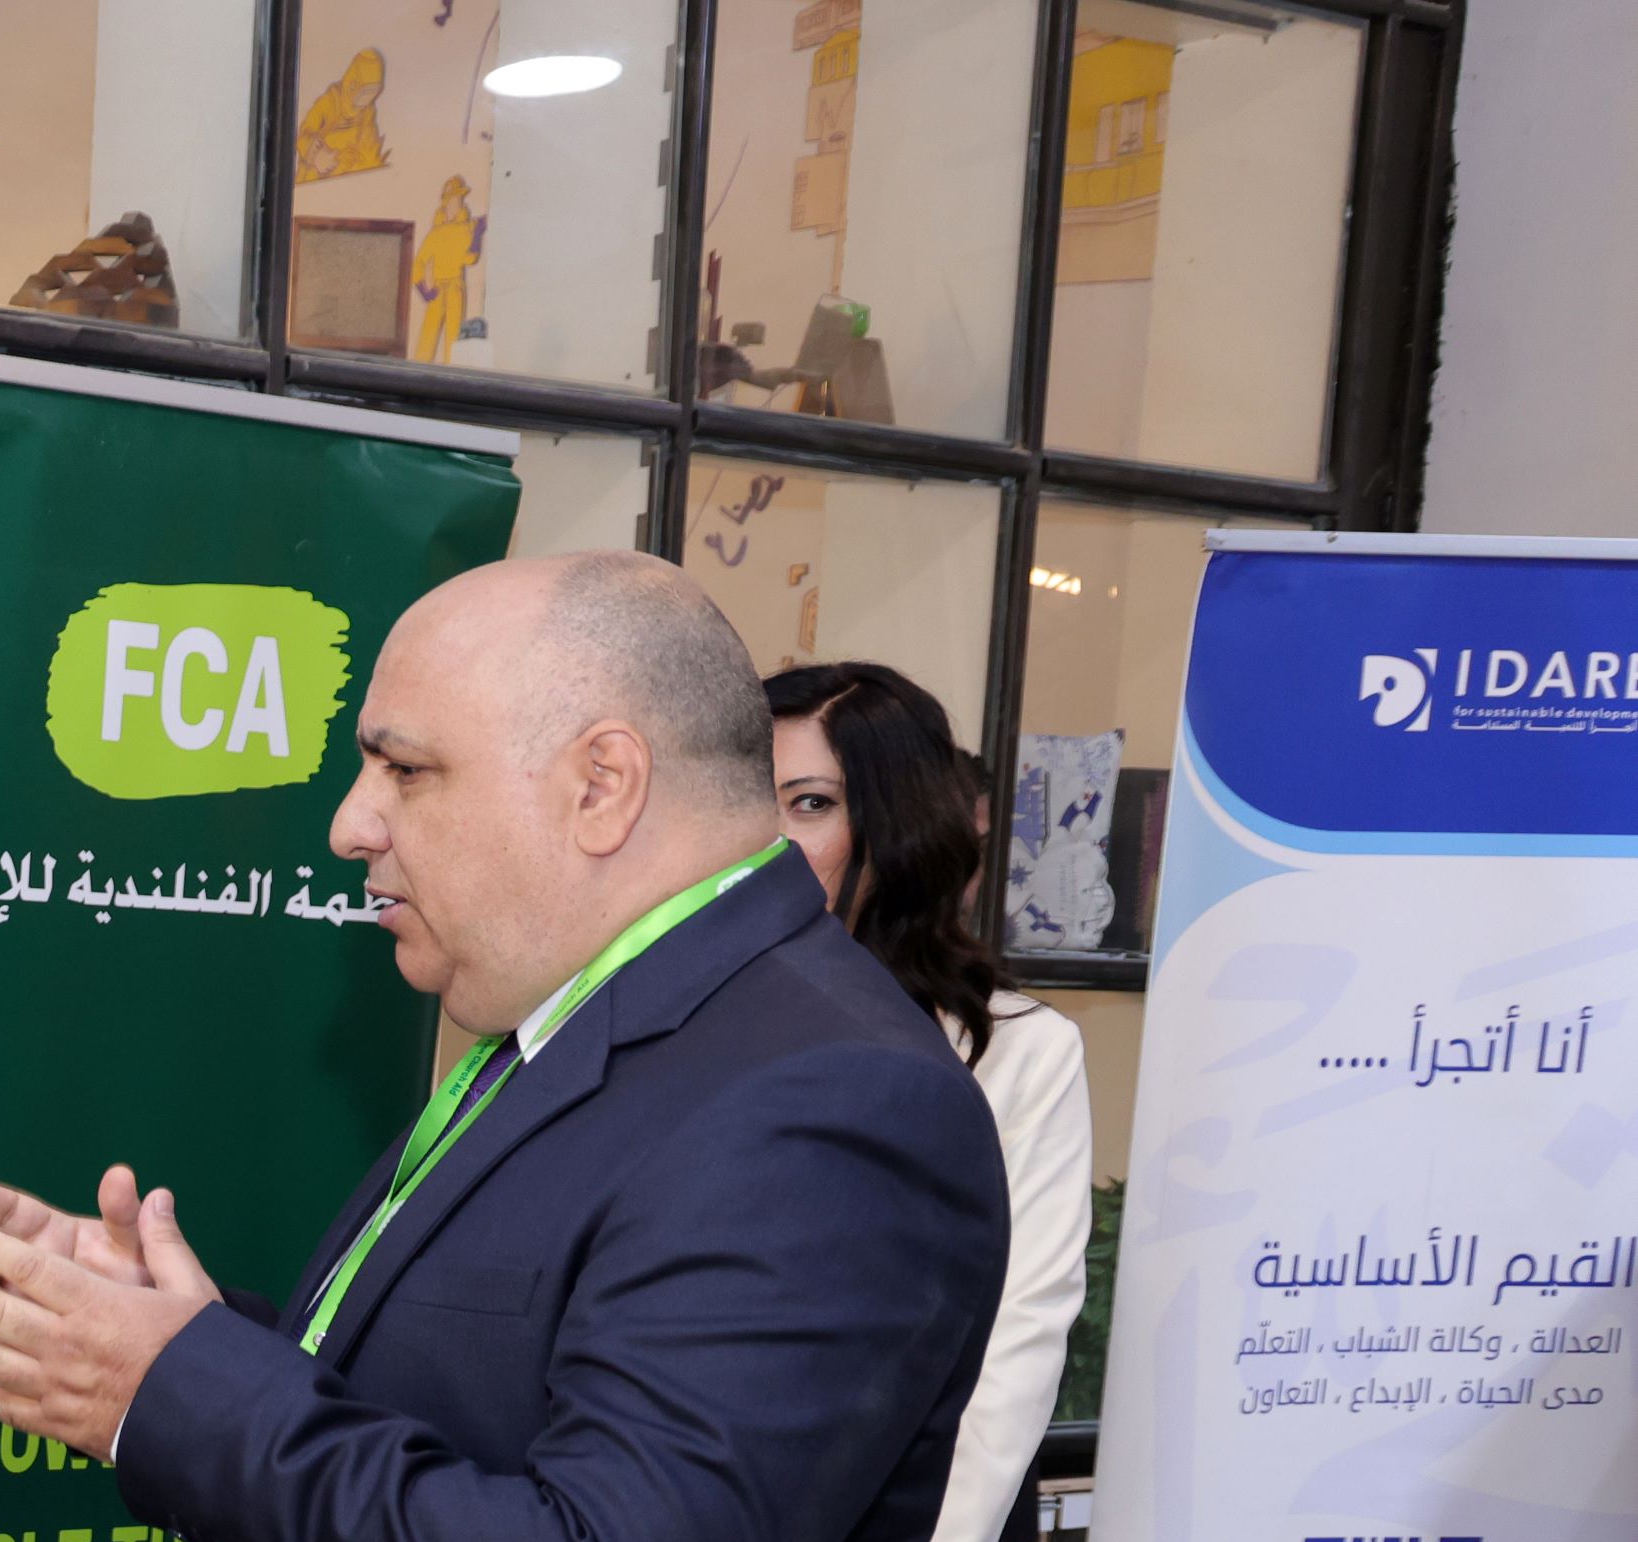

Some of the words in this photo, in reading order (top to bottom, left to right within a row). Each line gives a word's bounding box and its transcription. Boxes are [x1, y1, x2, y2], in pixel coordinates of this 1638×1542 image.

[101, 619, 291, 758] FCA
[1477, 706, 1563, 718] sustainable
[67, 850, 273, 924] الفنلندية
[1409, 1003, 1521, 1087] أتجرأ
[1536, 1005, 1594, 1073] أنا
[459, 1055, 482, 1082] Church
[448, 1082, 463, 1097] Aid
[1253, 1226, 1480, 1297] الأساسية
[1492, 1235, 1638, 1306] القيم
[1234, 1319, 1312, 1365] التعلّم
[1333, 1325, 1421, 1361] الشباب
[1428, 1324, 1503, 1361] وكالة
[1529, 1326, 1622, 1354] العدالة
[1238, 1377, 1328, 1414] التعاون
[1348, 1376, 1432, 1413] الإبداع
[1457, 1377, 1536, 1409] الحياة
[1541, 1385, 1604, 1410] مدى
